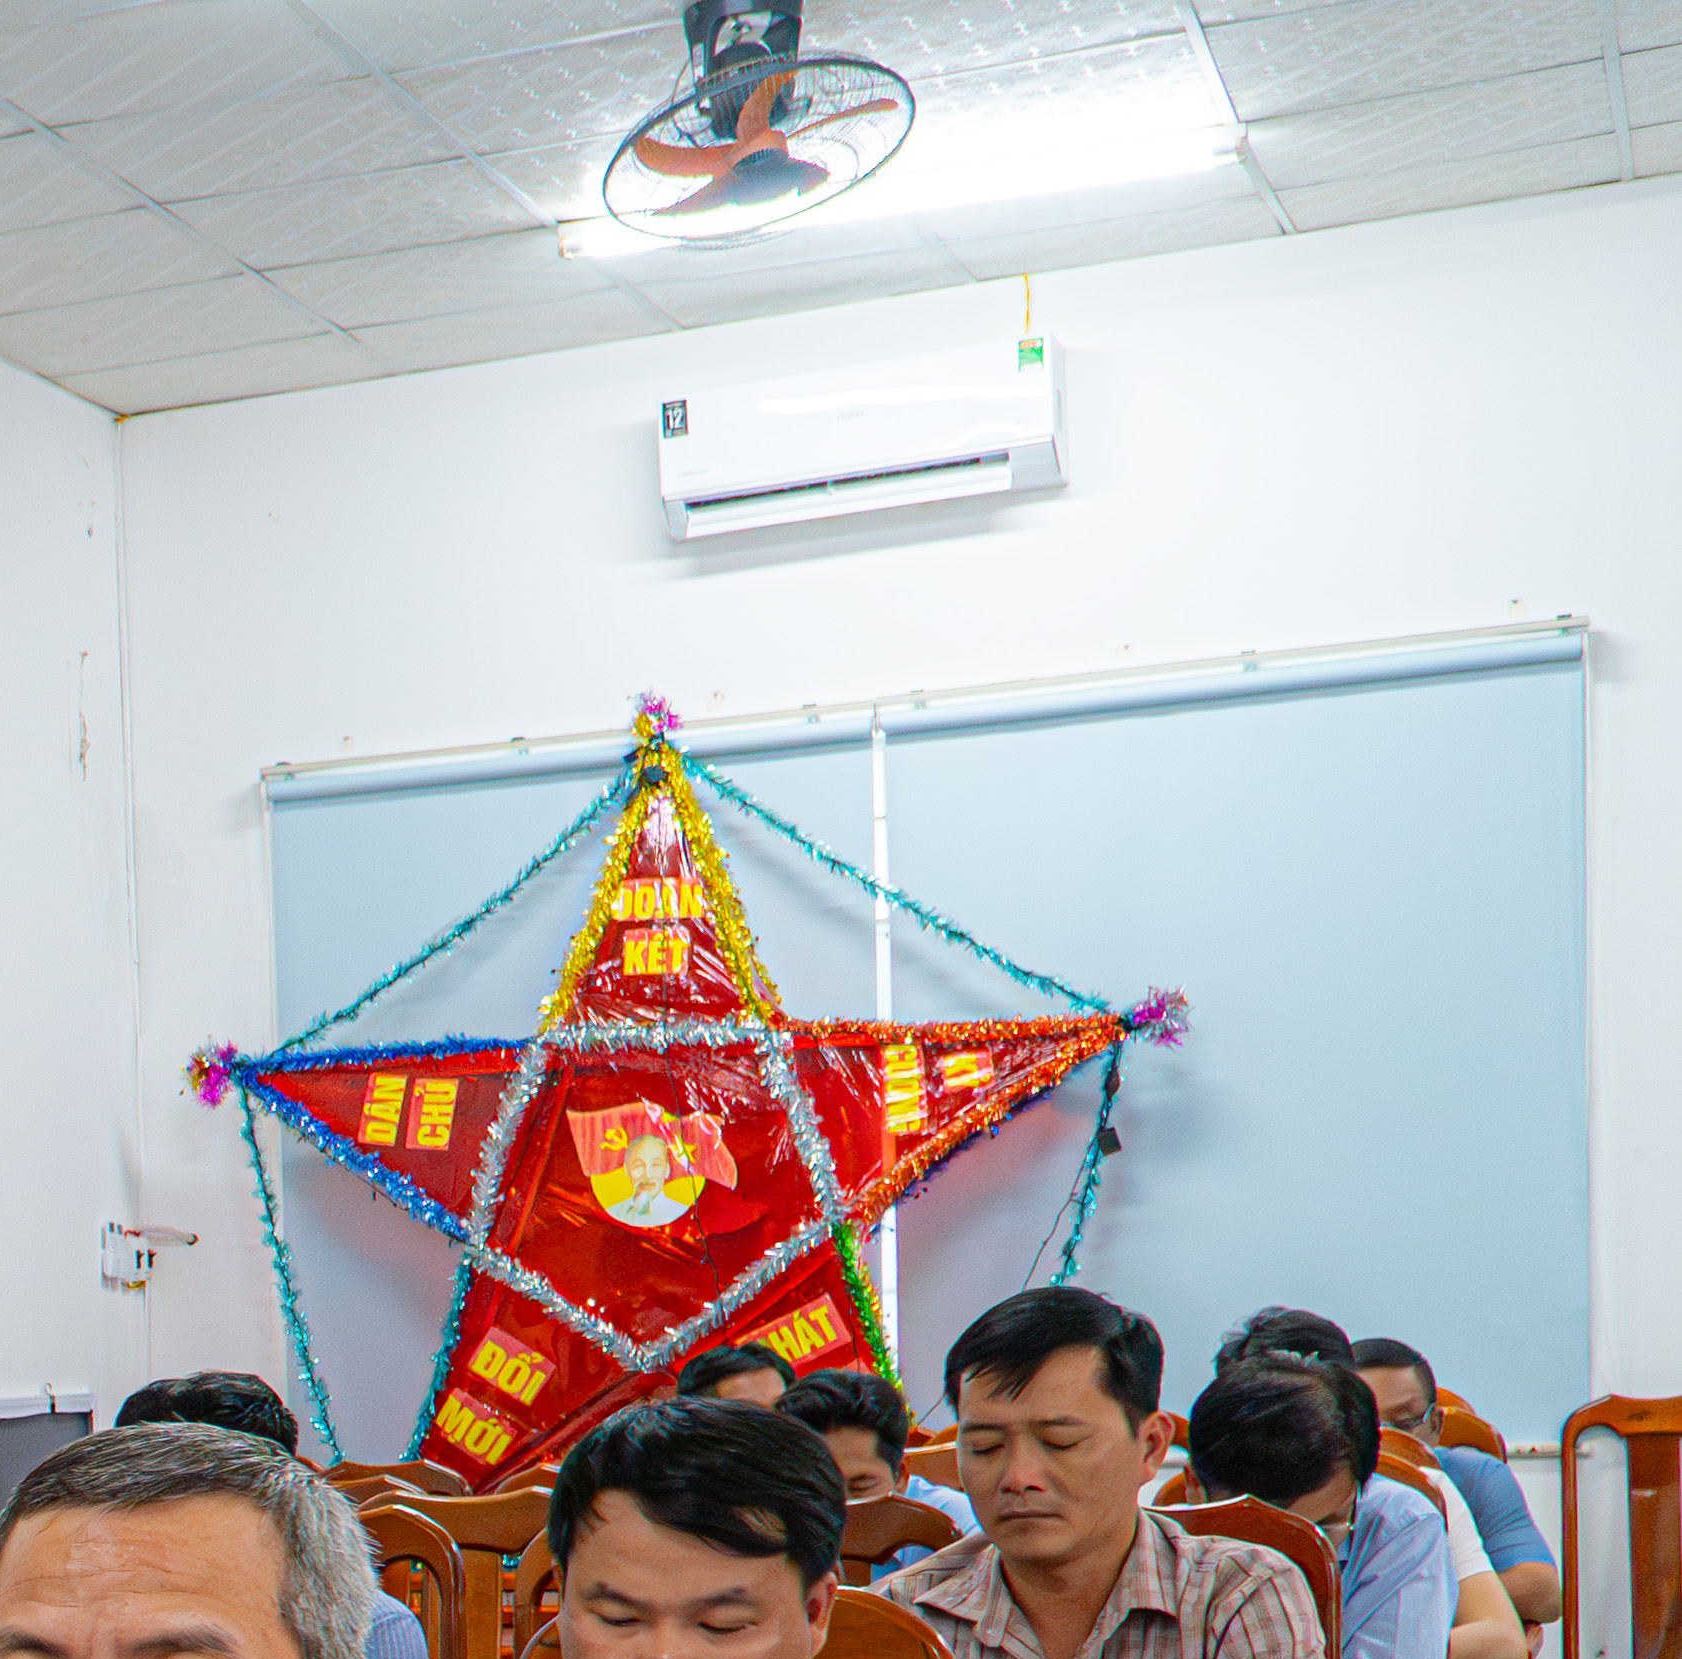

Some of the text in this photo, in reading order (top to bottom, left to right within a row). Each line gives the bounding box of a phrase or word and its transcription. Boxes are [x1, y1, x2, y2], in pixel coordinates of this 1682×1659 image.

[363, 1075, 407, 1144] DÂN
[414, 1082, 457, 1147] CHỦ
[757, 1305, 837, 1362] HÁT
[472, 1340, 546, 1406] ĐỔI
[436, 1394, 512, 1465] MỚI
